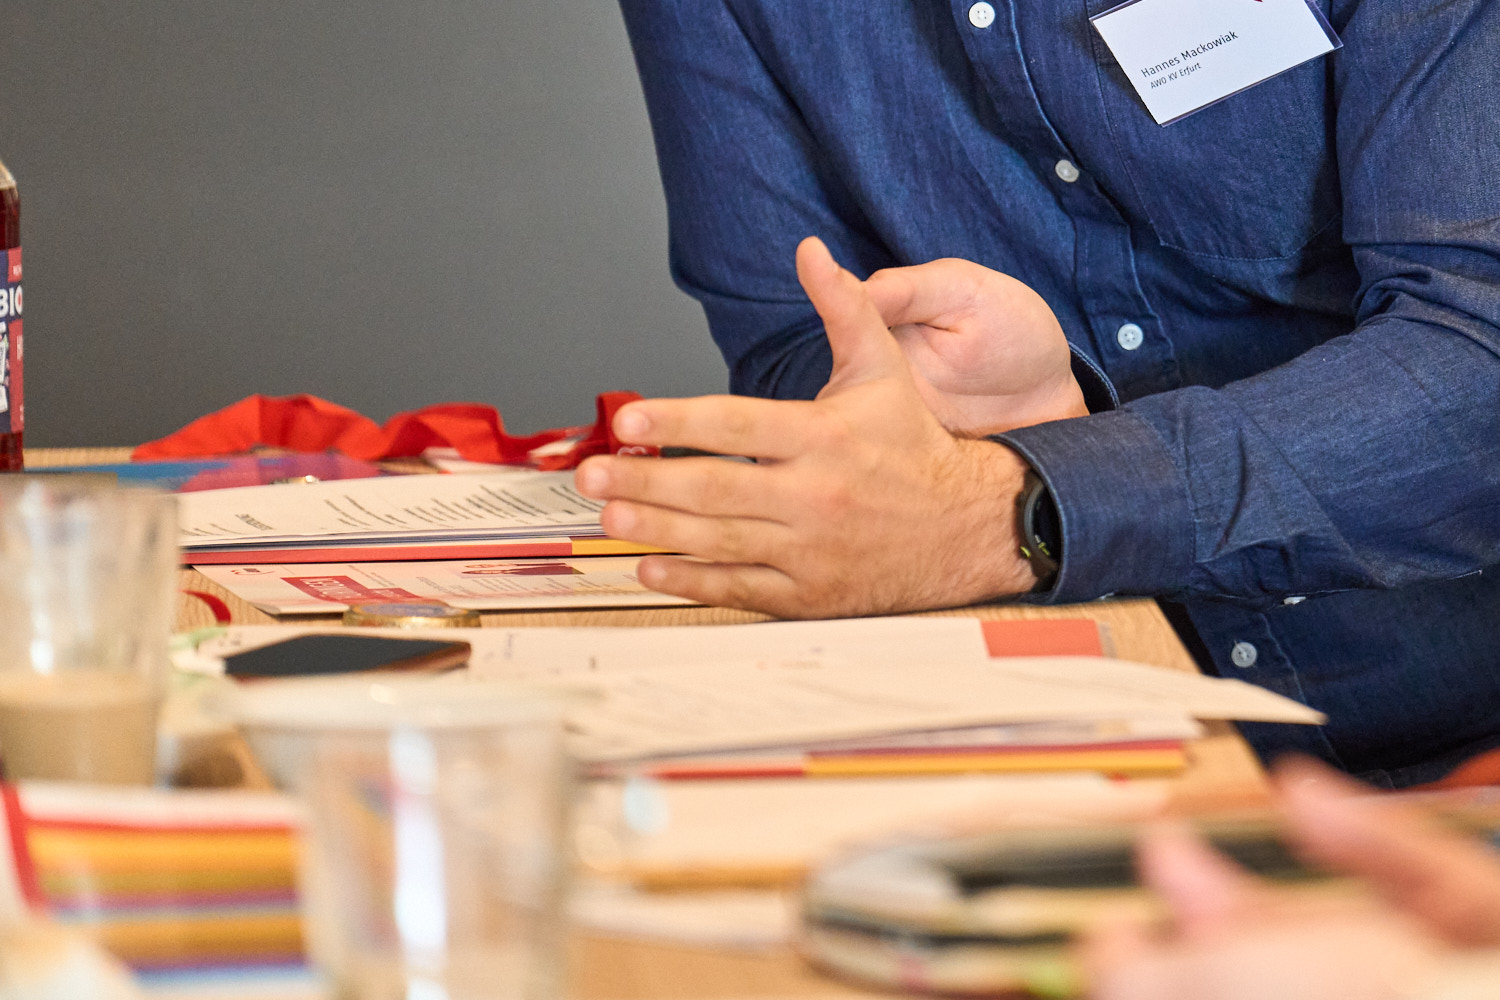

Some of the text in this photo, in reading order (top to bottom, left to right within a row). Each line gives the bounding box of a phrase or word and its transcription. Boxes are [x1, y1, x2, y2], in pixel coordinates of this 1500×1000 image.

[1141, 30, 1239, 78] Hannes Mackowiak
[1150, 62, 1202, 90] AWO KV Erfurt
